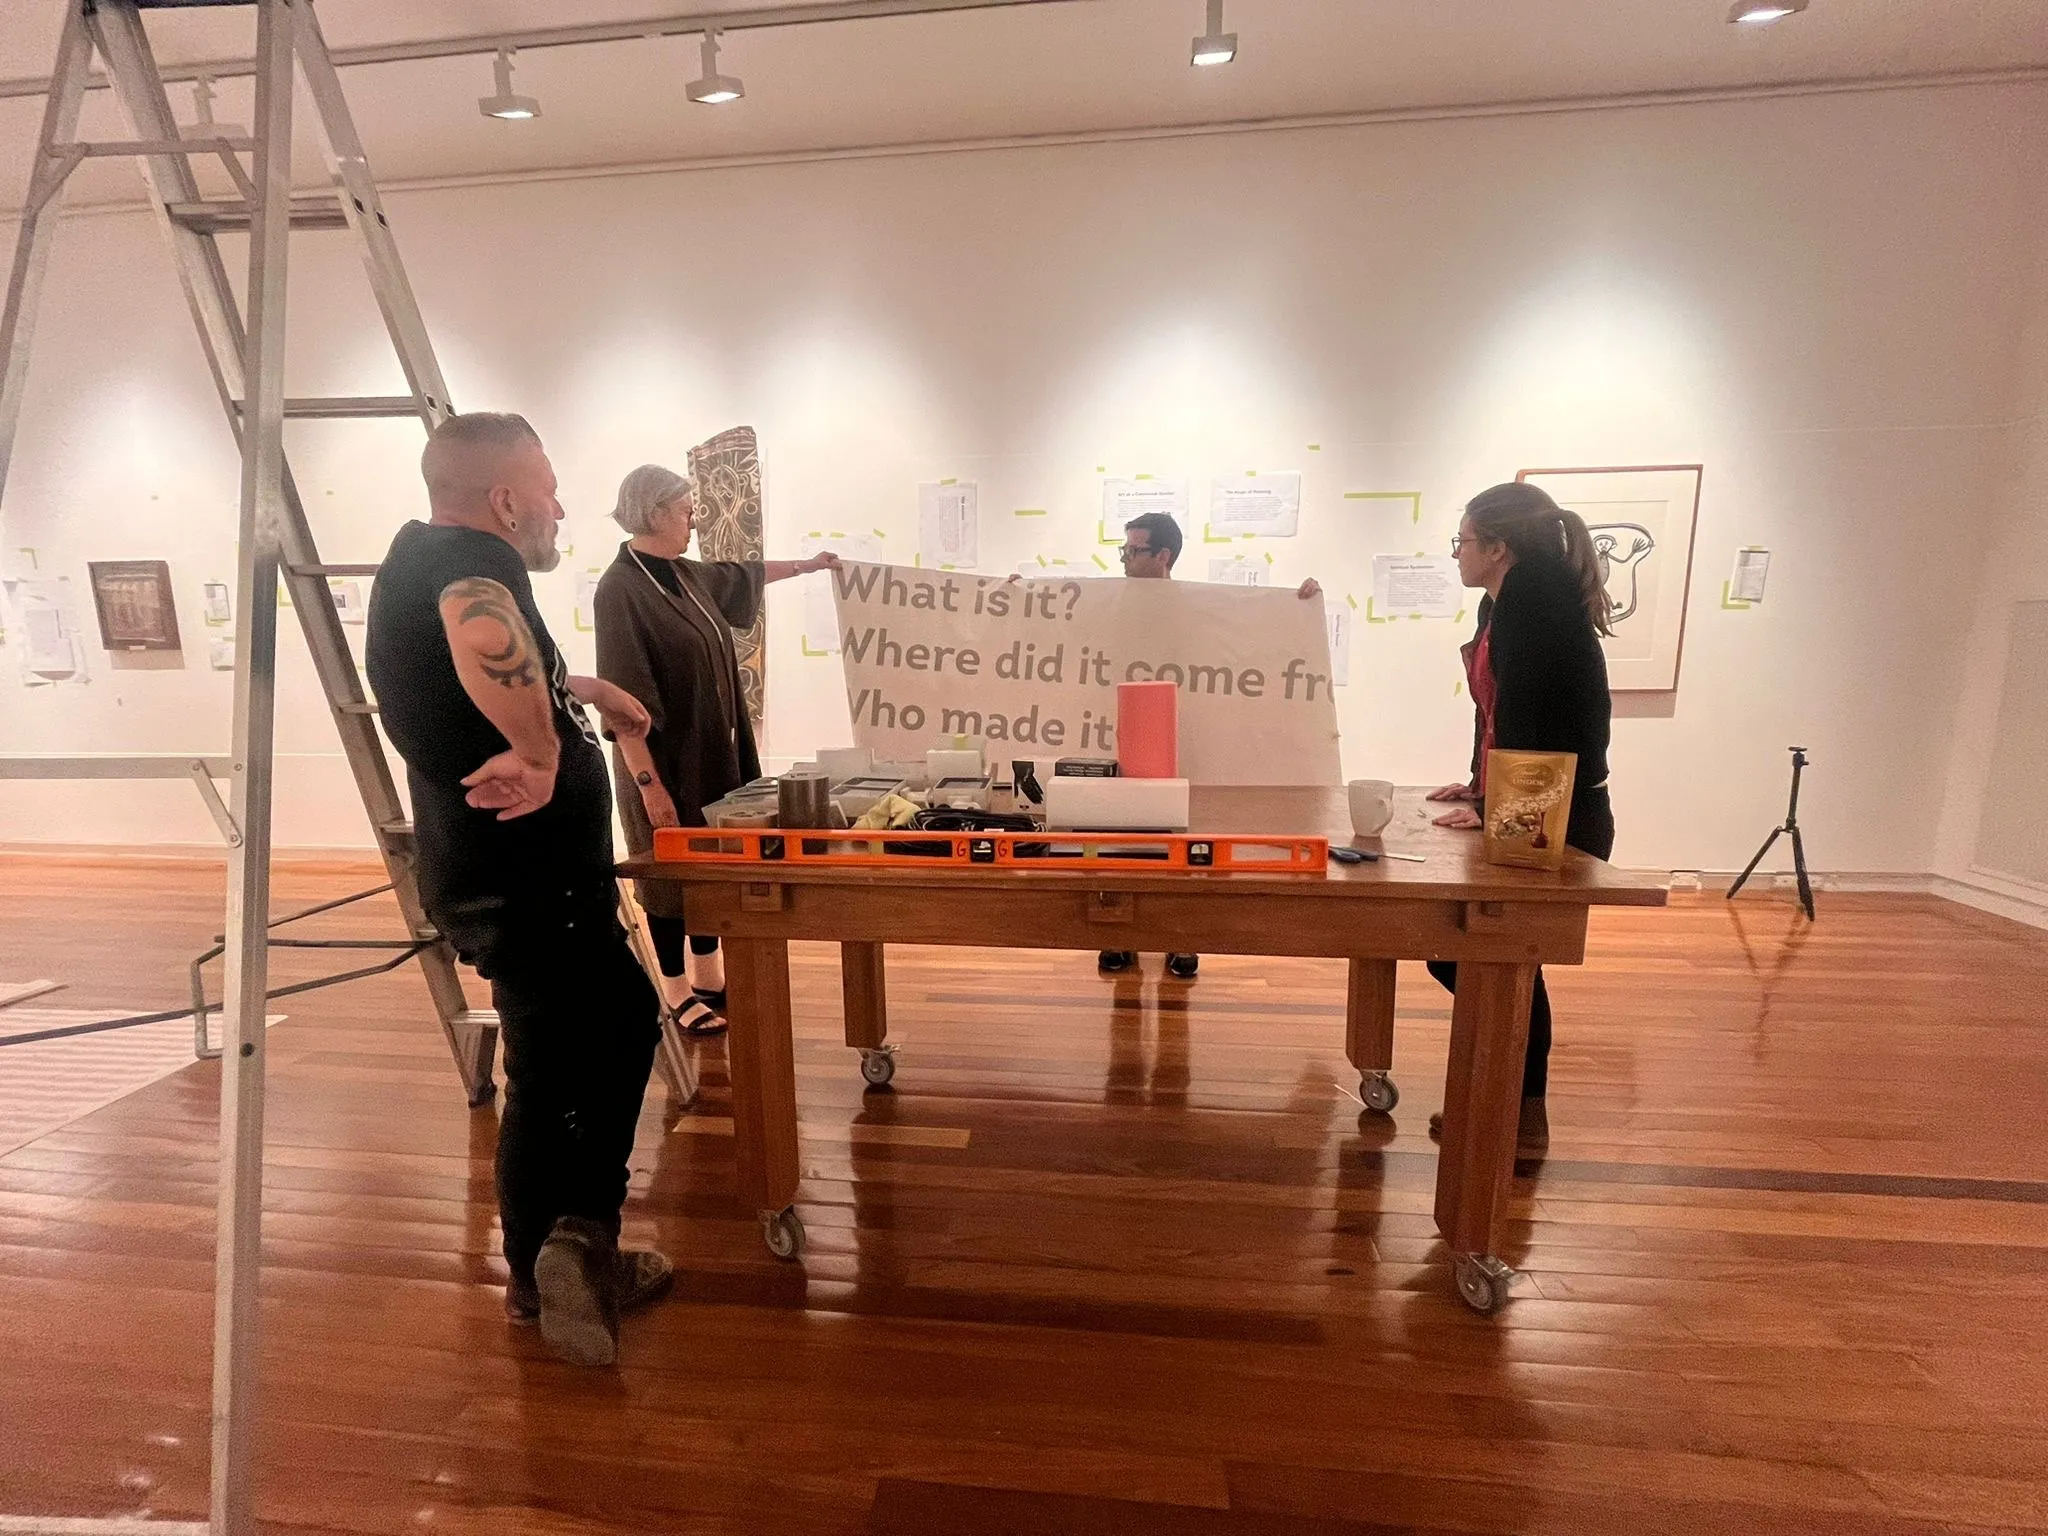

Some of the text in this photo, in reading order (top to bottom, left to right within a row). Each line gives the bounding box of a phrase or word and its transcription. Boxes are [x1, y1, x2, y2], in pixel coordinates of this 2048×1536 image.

[836, 565, 1082, 621] What is it?
[842, 627, 1335, 703] Where did it come fr
[941, 704, 1066, 746] made
[1080, 710, 1114, 751] it
[956, 840, 1008, 857] G G
